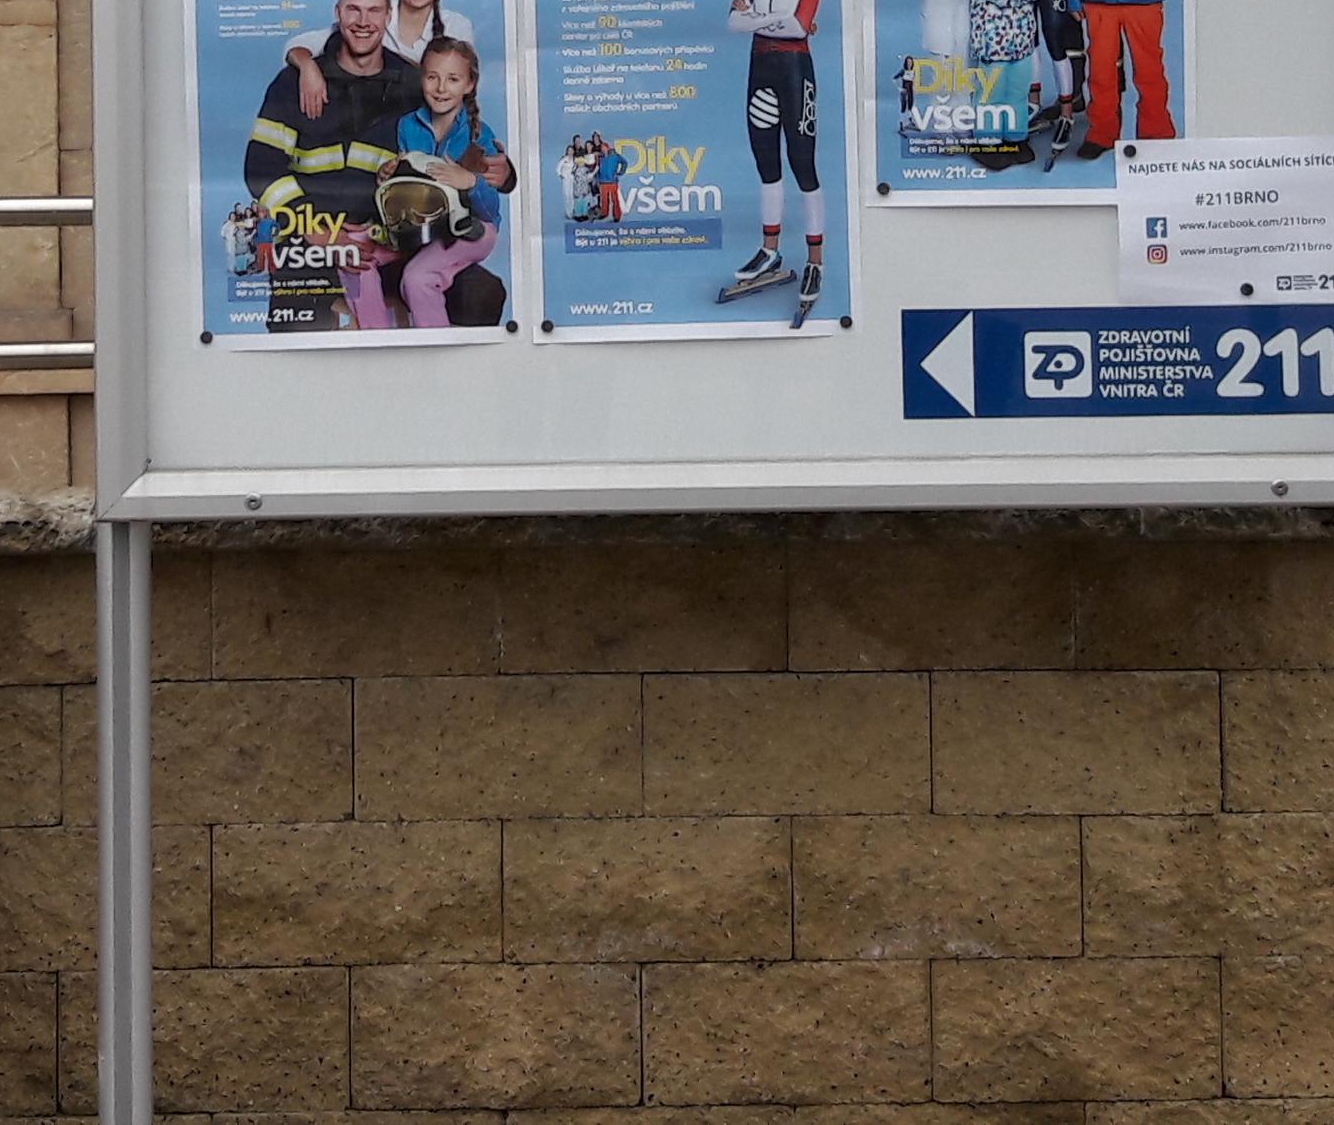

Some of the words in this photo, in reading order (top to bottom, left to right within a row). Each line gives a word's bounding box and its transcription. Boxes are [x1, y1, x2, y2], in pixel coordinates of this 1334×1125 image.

[914, 55, 1003, 103] Díky
[910, 94, 1016, 132] všem
[614, 136, 706, 184] Díky
[1128, 162, 1179, 175] NAJDETE
[1181, 158, 1206, 172] NÁS
[1208, 160, 1227, 171] NA
[1229, 155, 1301, 170] SOCIÁLNÍCH
[902, 165, 987, 179] www.211.cz
[617, 175, 722, 214] všem
[1195, 189, 1279, 206] #211BRNO
[269, 203, 346, 244] Díky
[1178, 215, 1326, 231] www.facebook.com/211brno
[271, 237, 360, 268] všem
[1179, 241, 1333, 257] www.instagram.com/211brno
[229, 308, 315, 323] www.211.cz
[569, 301, 654, 315] www.211.cz
[1098, 326, 1191, 345] ZDRAVOTNÍ
[1098, 343, 1201, 362] POJIŠŤOVNA
[1098, 365, 1214, 381] MINISTERSTVA
[1098, 383, 1159, 398] VNITRA
[1162, 379, 1185, 398] ČR
